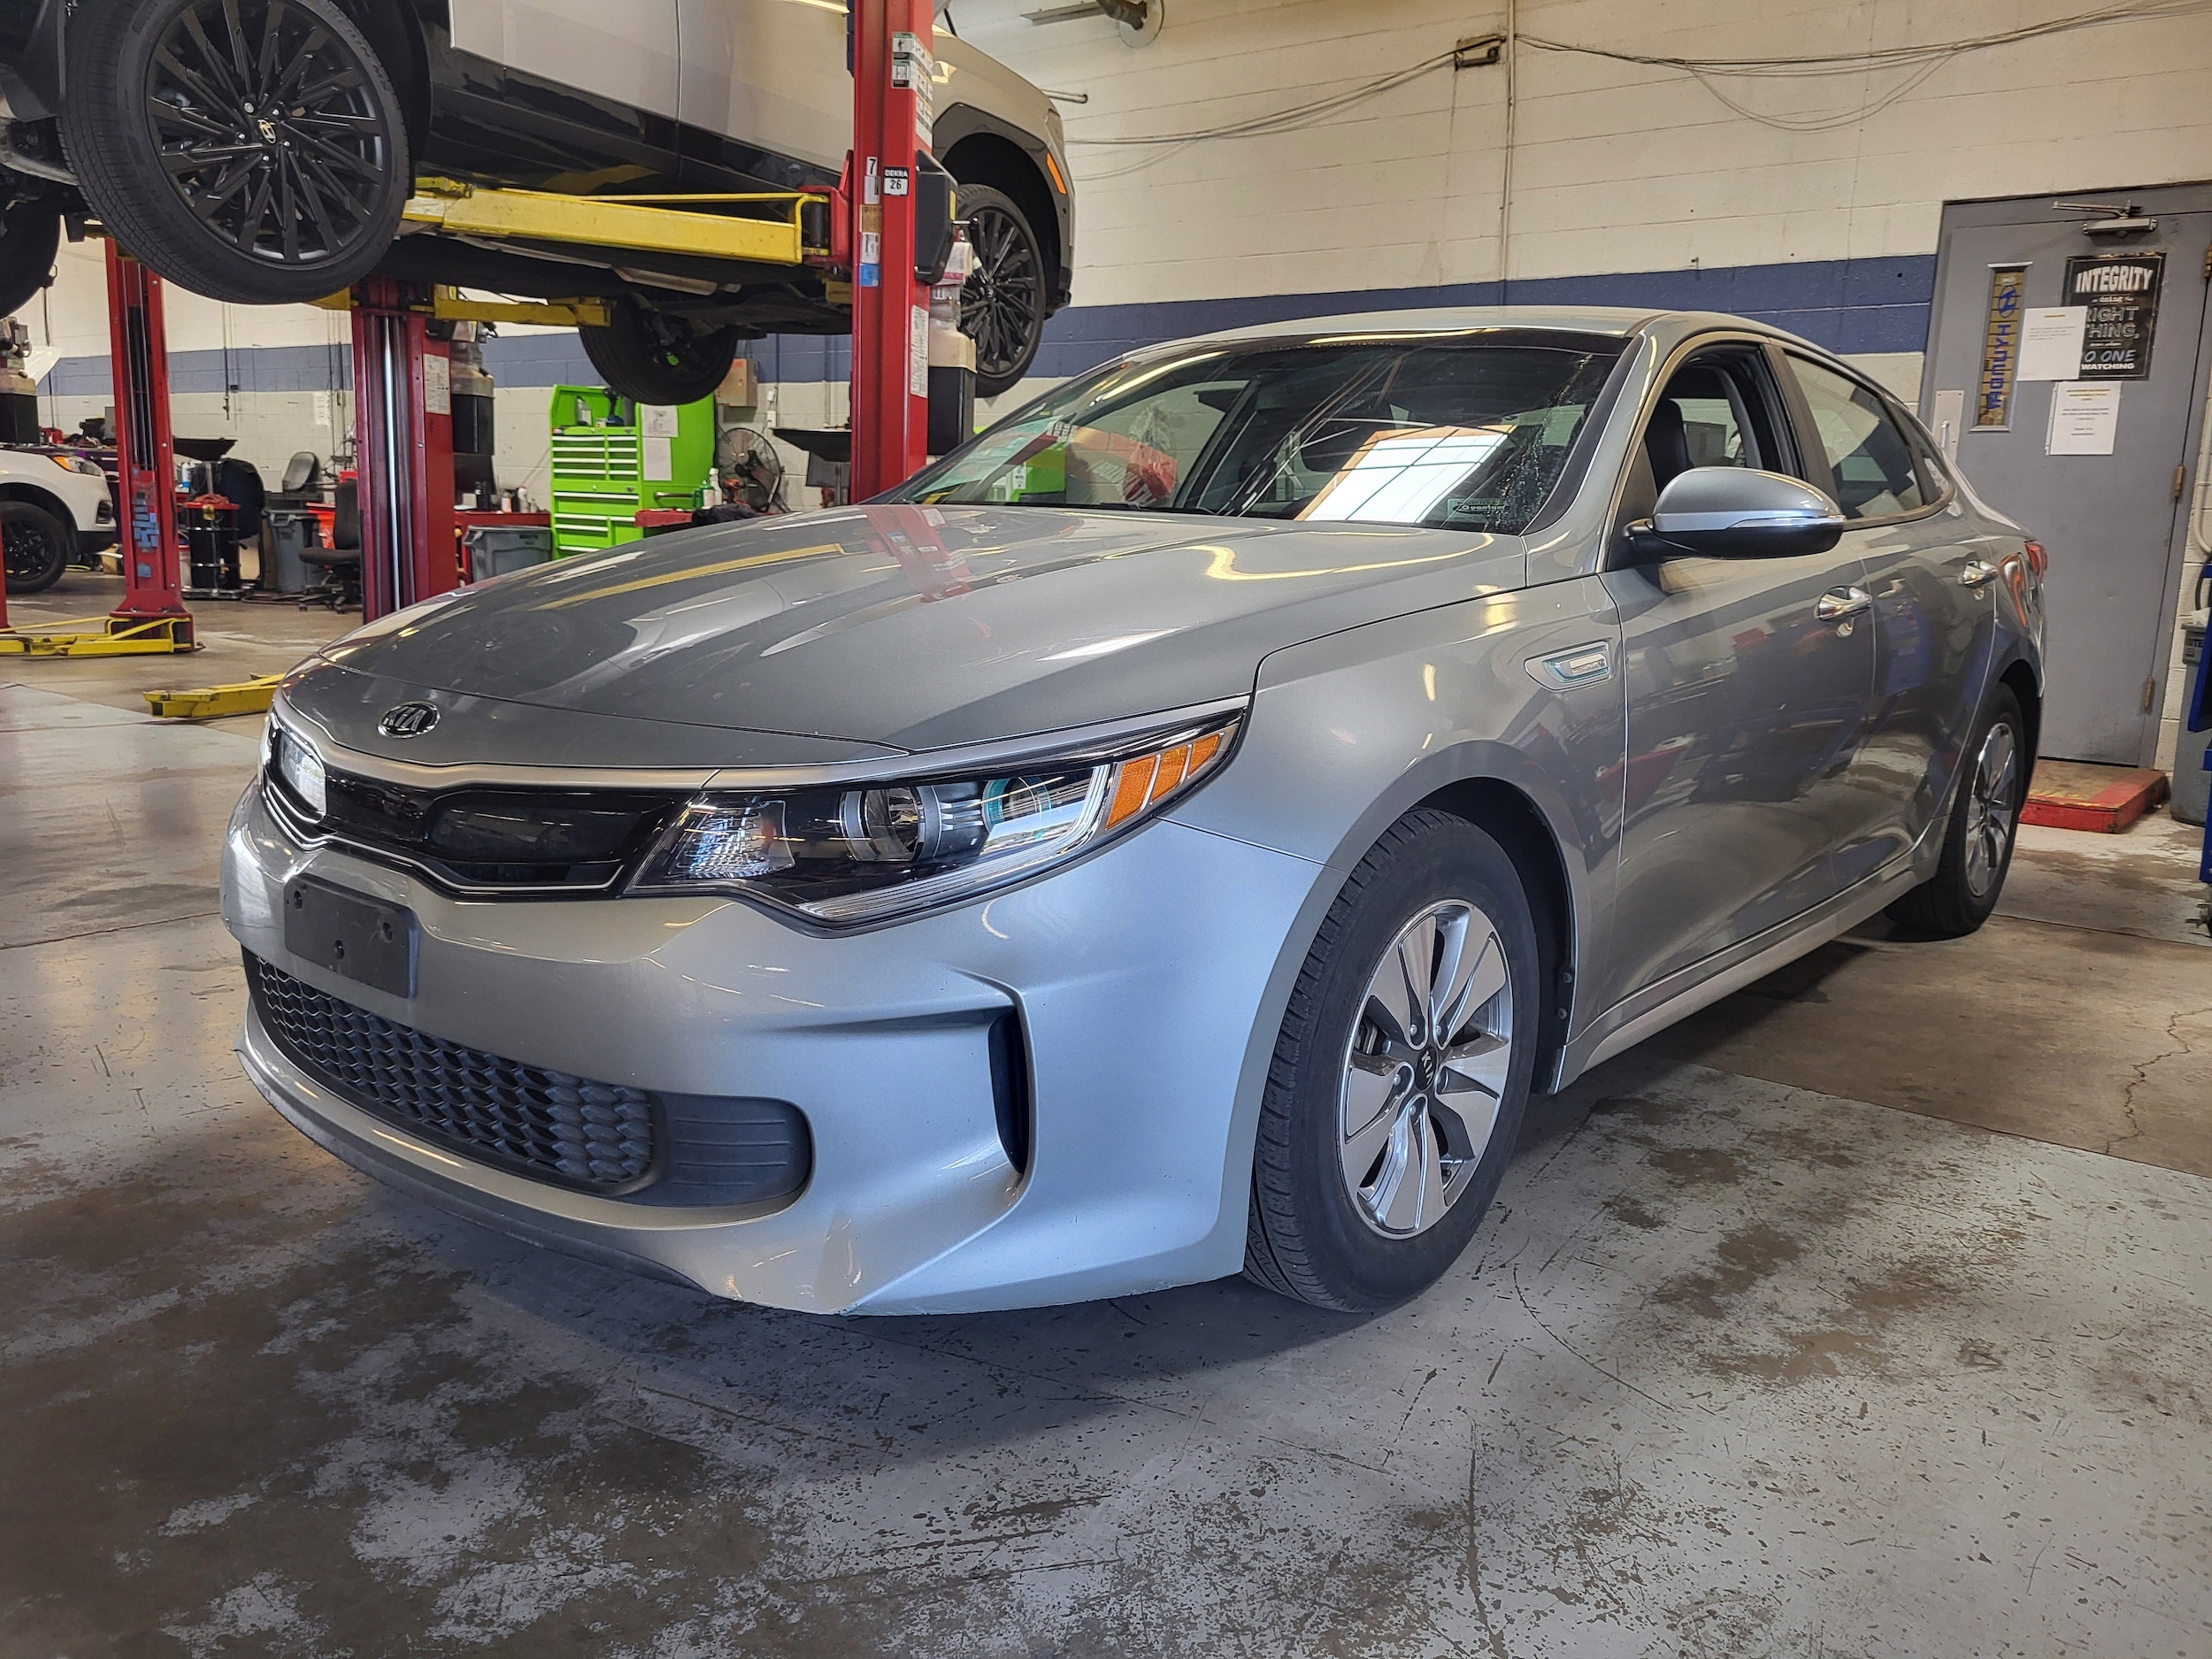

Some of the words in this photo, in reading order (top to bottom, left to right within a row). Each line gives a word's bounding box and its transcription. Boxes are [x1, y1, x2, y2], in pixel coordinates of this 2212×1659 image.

[869, 158, 876, 175] 7
[890, 179, 902, 190] 26
[2075, 265, 2154, 294] INTEGRITY
[2085, 322, 2140, 340] HING,
[2101, 349, 2137, 363] ONE
[382, 705, 428, 732] KIA
[1420, 1048, 1434, 1086] KIA
